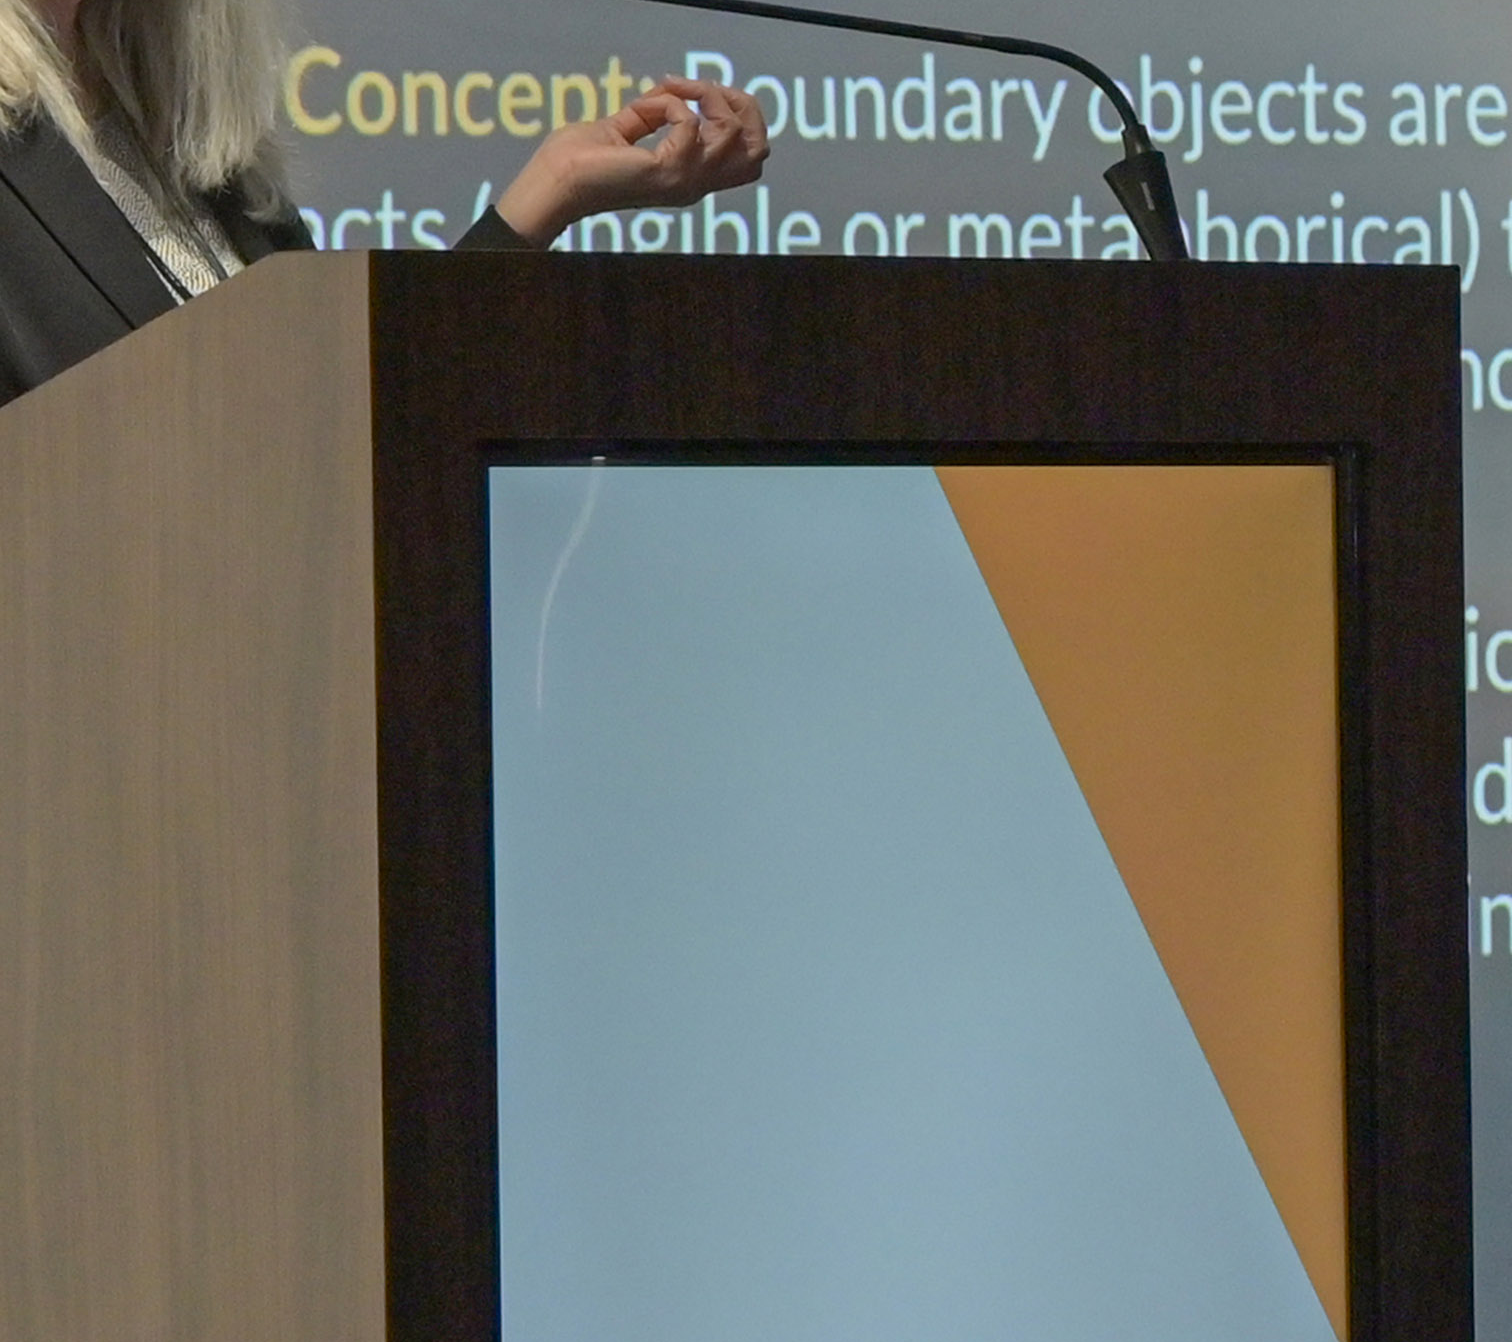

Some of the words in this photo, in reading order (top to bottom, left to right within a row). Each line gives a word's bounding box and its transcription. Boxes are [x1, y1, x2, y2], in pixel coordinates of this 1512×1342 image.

[1088, 53, 1368, 163] objects
[1388, 79, 1510, 147] are
[842, 207, 926, 257] or
[946, 189, 1481, 293] metahorical)
